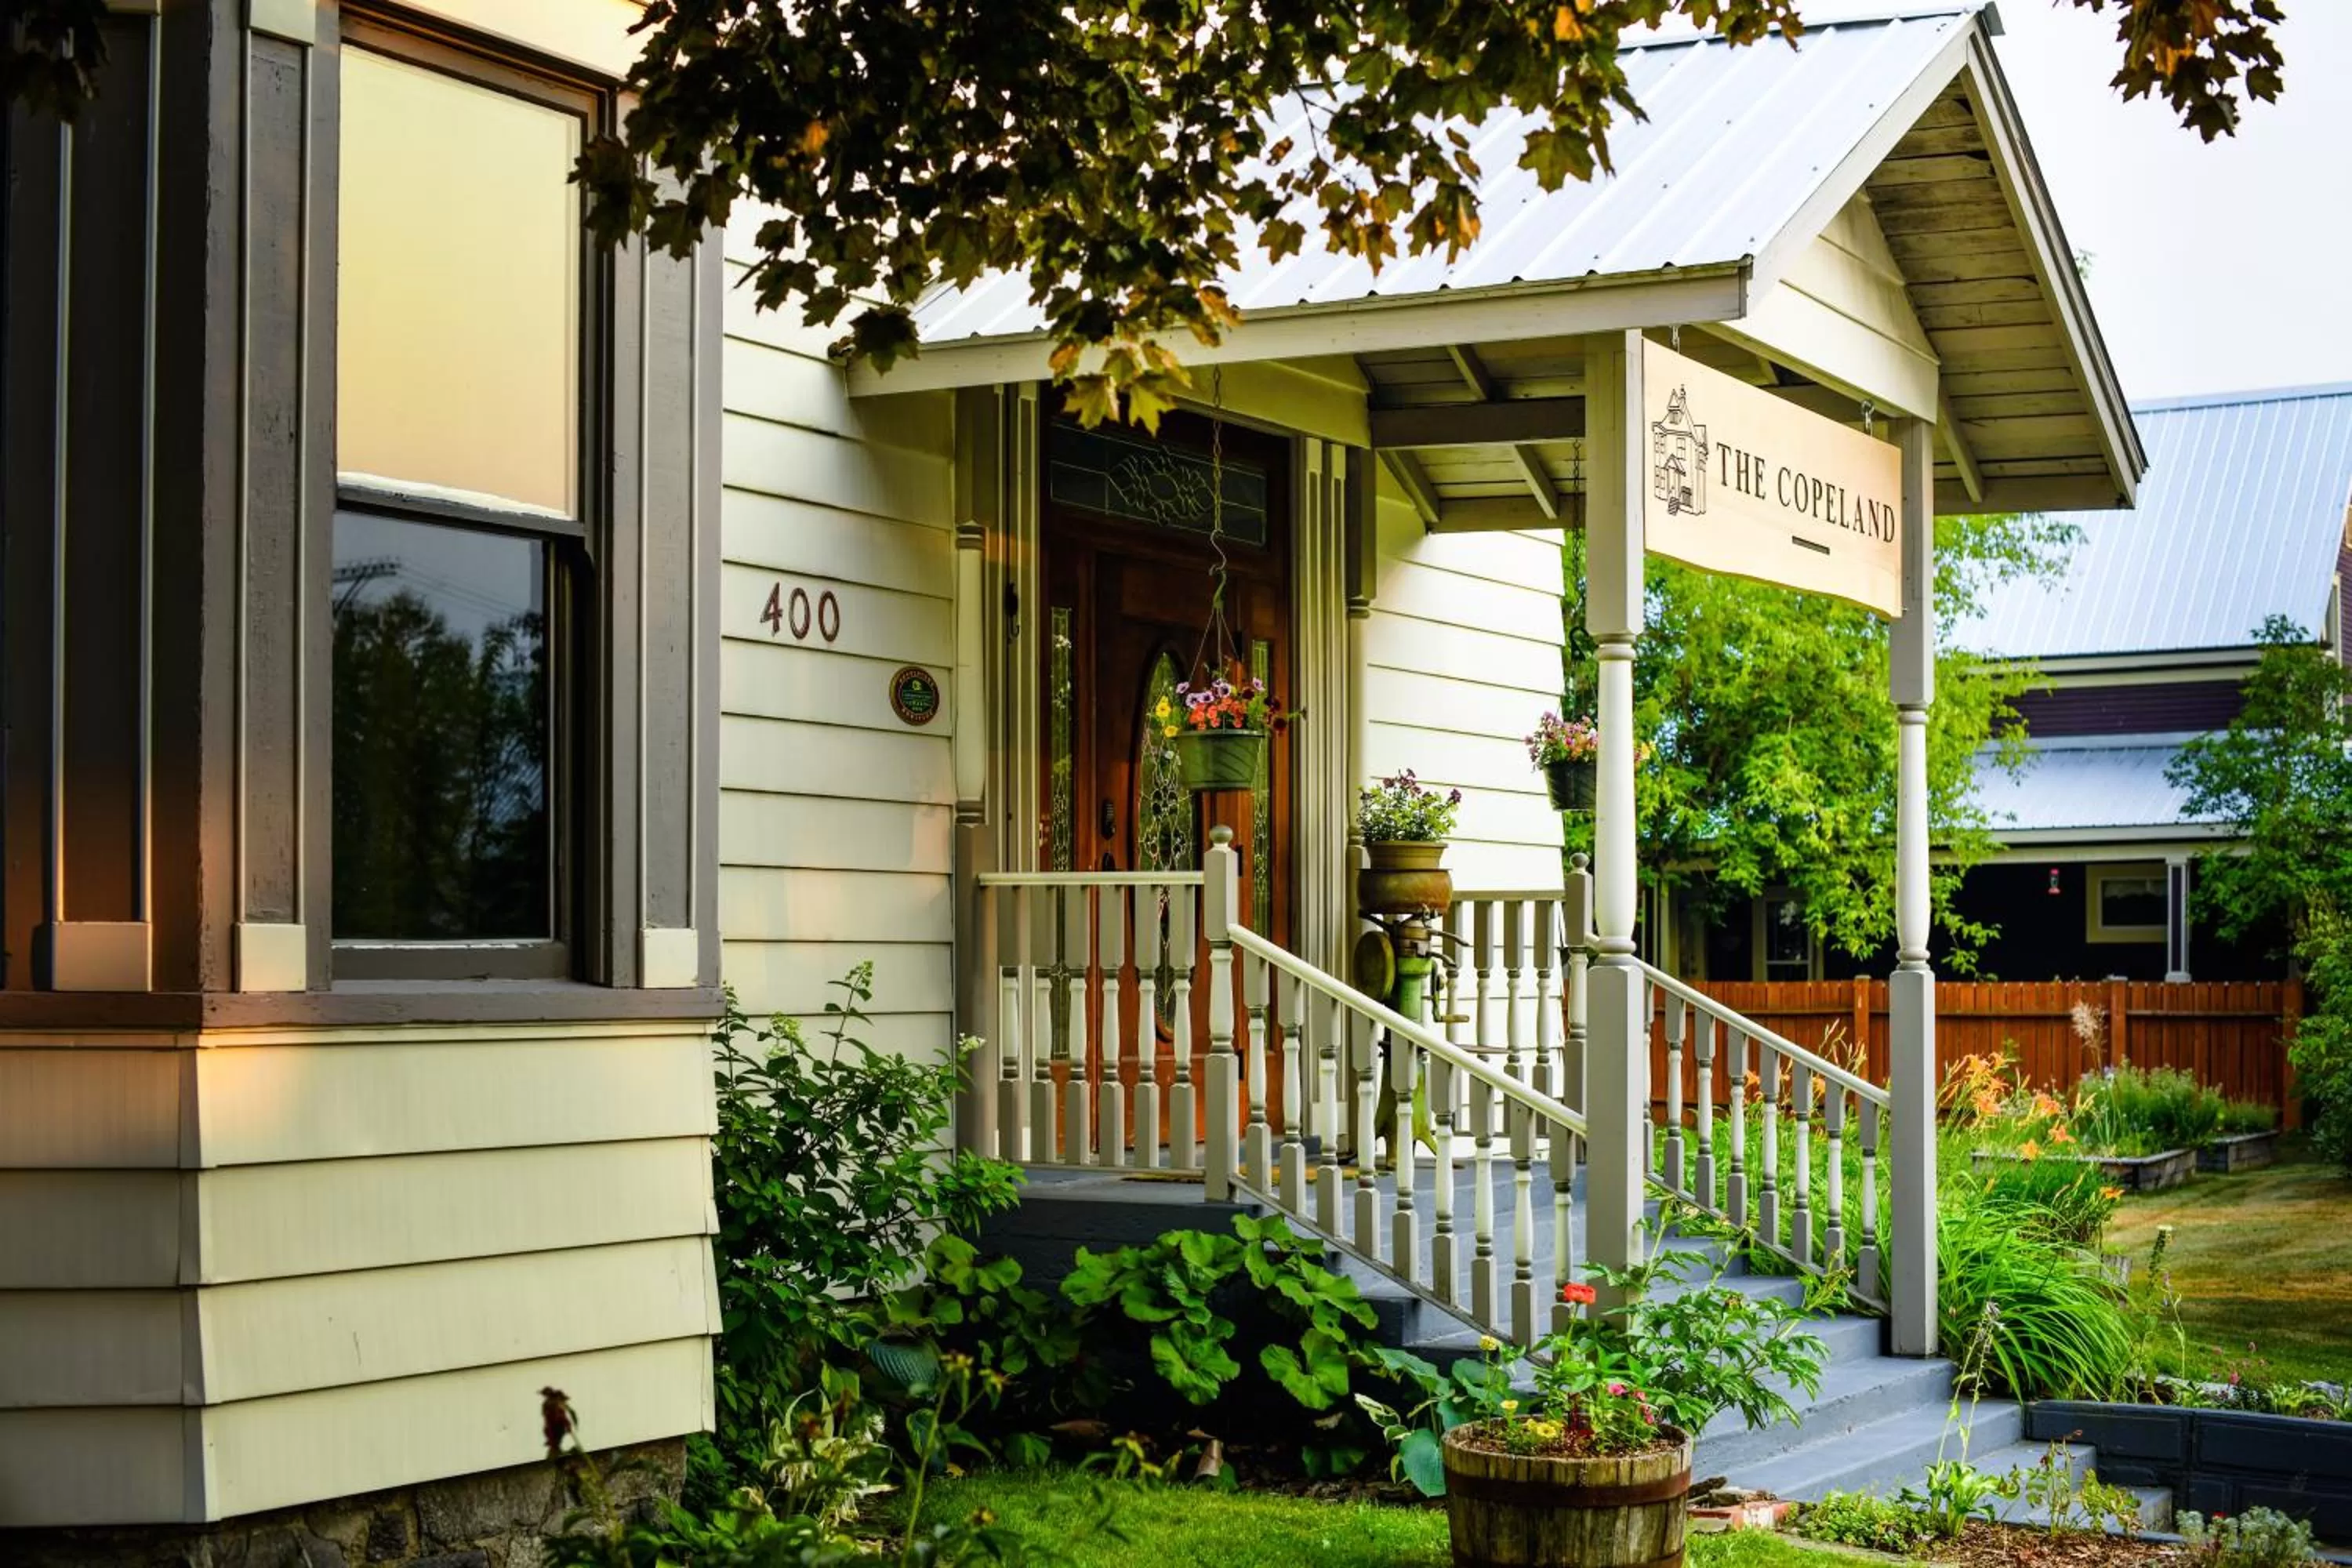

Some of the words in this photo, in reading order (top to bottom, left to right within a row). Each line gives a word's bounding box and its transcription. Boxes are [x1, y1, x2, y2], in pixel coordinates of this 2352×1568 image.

[1716, 442, 1766, 500] THE
[1777, 466, 1895, 543] COPELAND
[760, 581, 840, 642] 400
